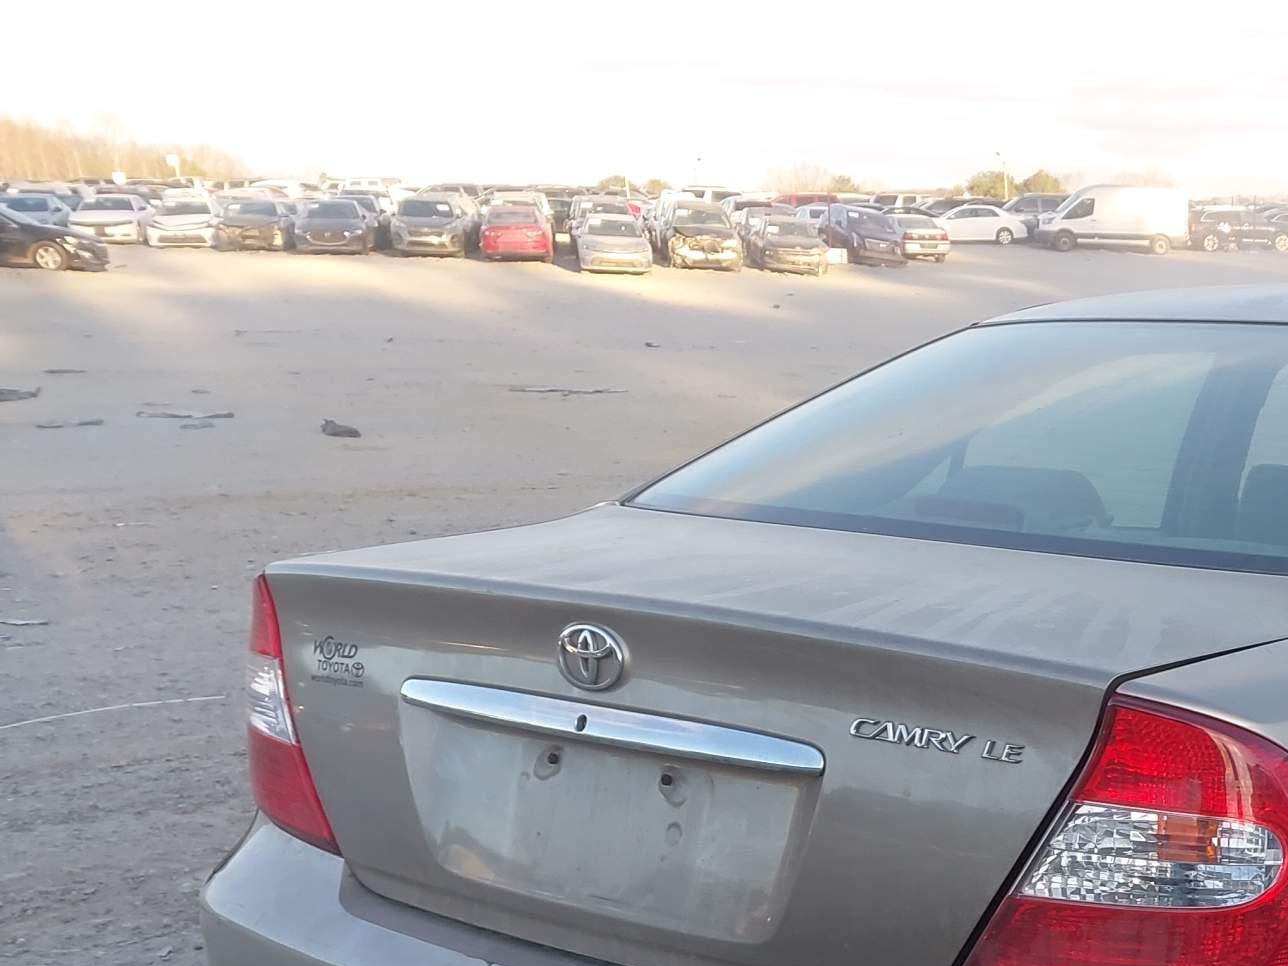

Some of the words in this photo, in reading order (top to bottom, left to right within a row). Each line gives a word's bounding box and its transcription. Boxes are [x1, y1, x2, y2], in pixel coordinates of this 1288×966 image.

[313, 636, 358, 660] WORLD
[318, 660, 350, 673] TOYOTA
[850, 717, 976, 754] CAMRY
[980, 739, 1025, 764] LE
